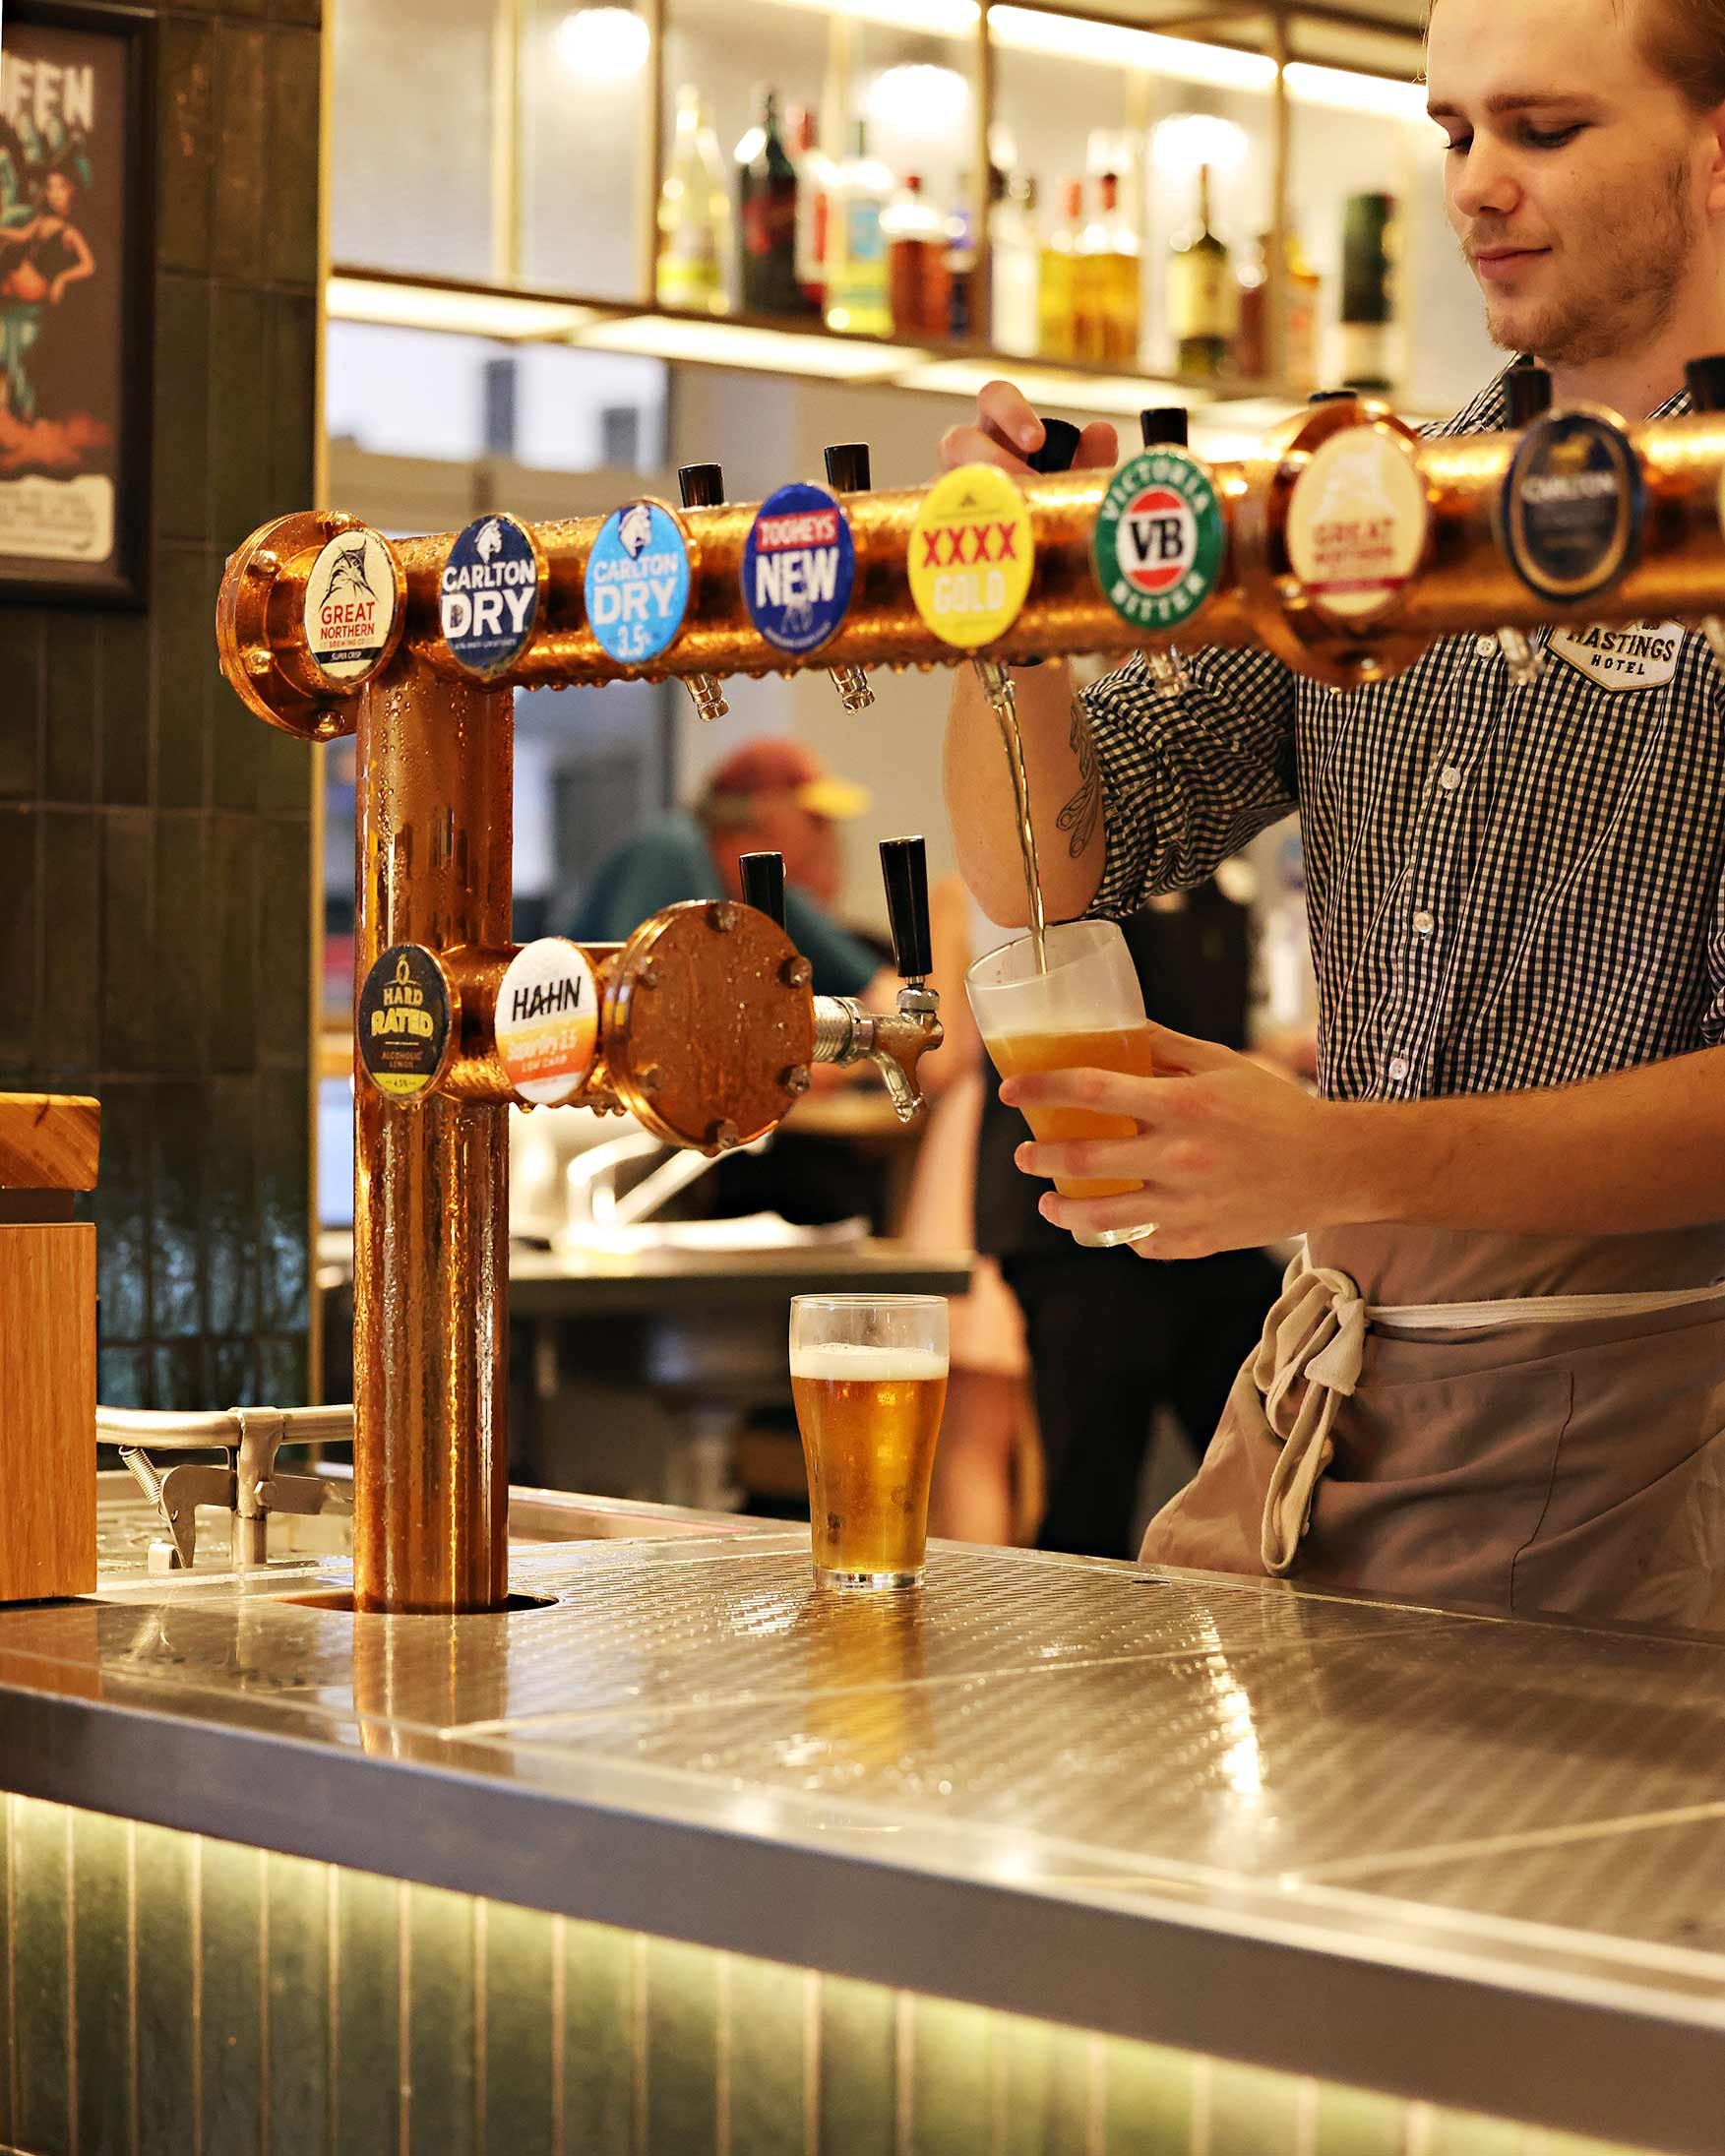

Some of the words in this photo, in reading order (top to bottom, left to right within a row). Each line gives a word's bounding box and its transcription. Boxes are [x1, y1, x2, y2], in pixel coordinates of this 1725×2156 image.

[923, 522, 1017, 568] XXXX
[1129, 518, 1183, 561] VB
[443, 559, 536, 590] CARLTON
[593, 553, 678, 583] CARLTON
[756, 547, 839, 608] NEW
[593, 578, 677, 625] DRY
[935, 570, 1006, 615] GOLD
[321, 601, 375, 625] GREAT
[441, 586, 535, 639] DRY
[320, 623, 375, 640] NORTHERN
[1590, 654, 1645, 675] HOTEL
[383, 987, 423, 1007] HARD
[512, 976, 582, 1021] HAHN
[371, 1008, 434, 1037] RATED
